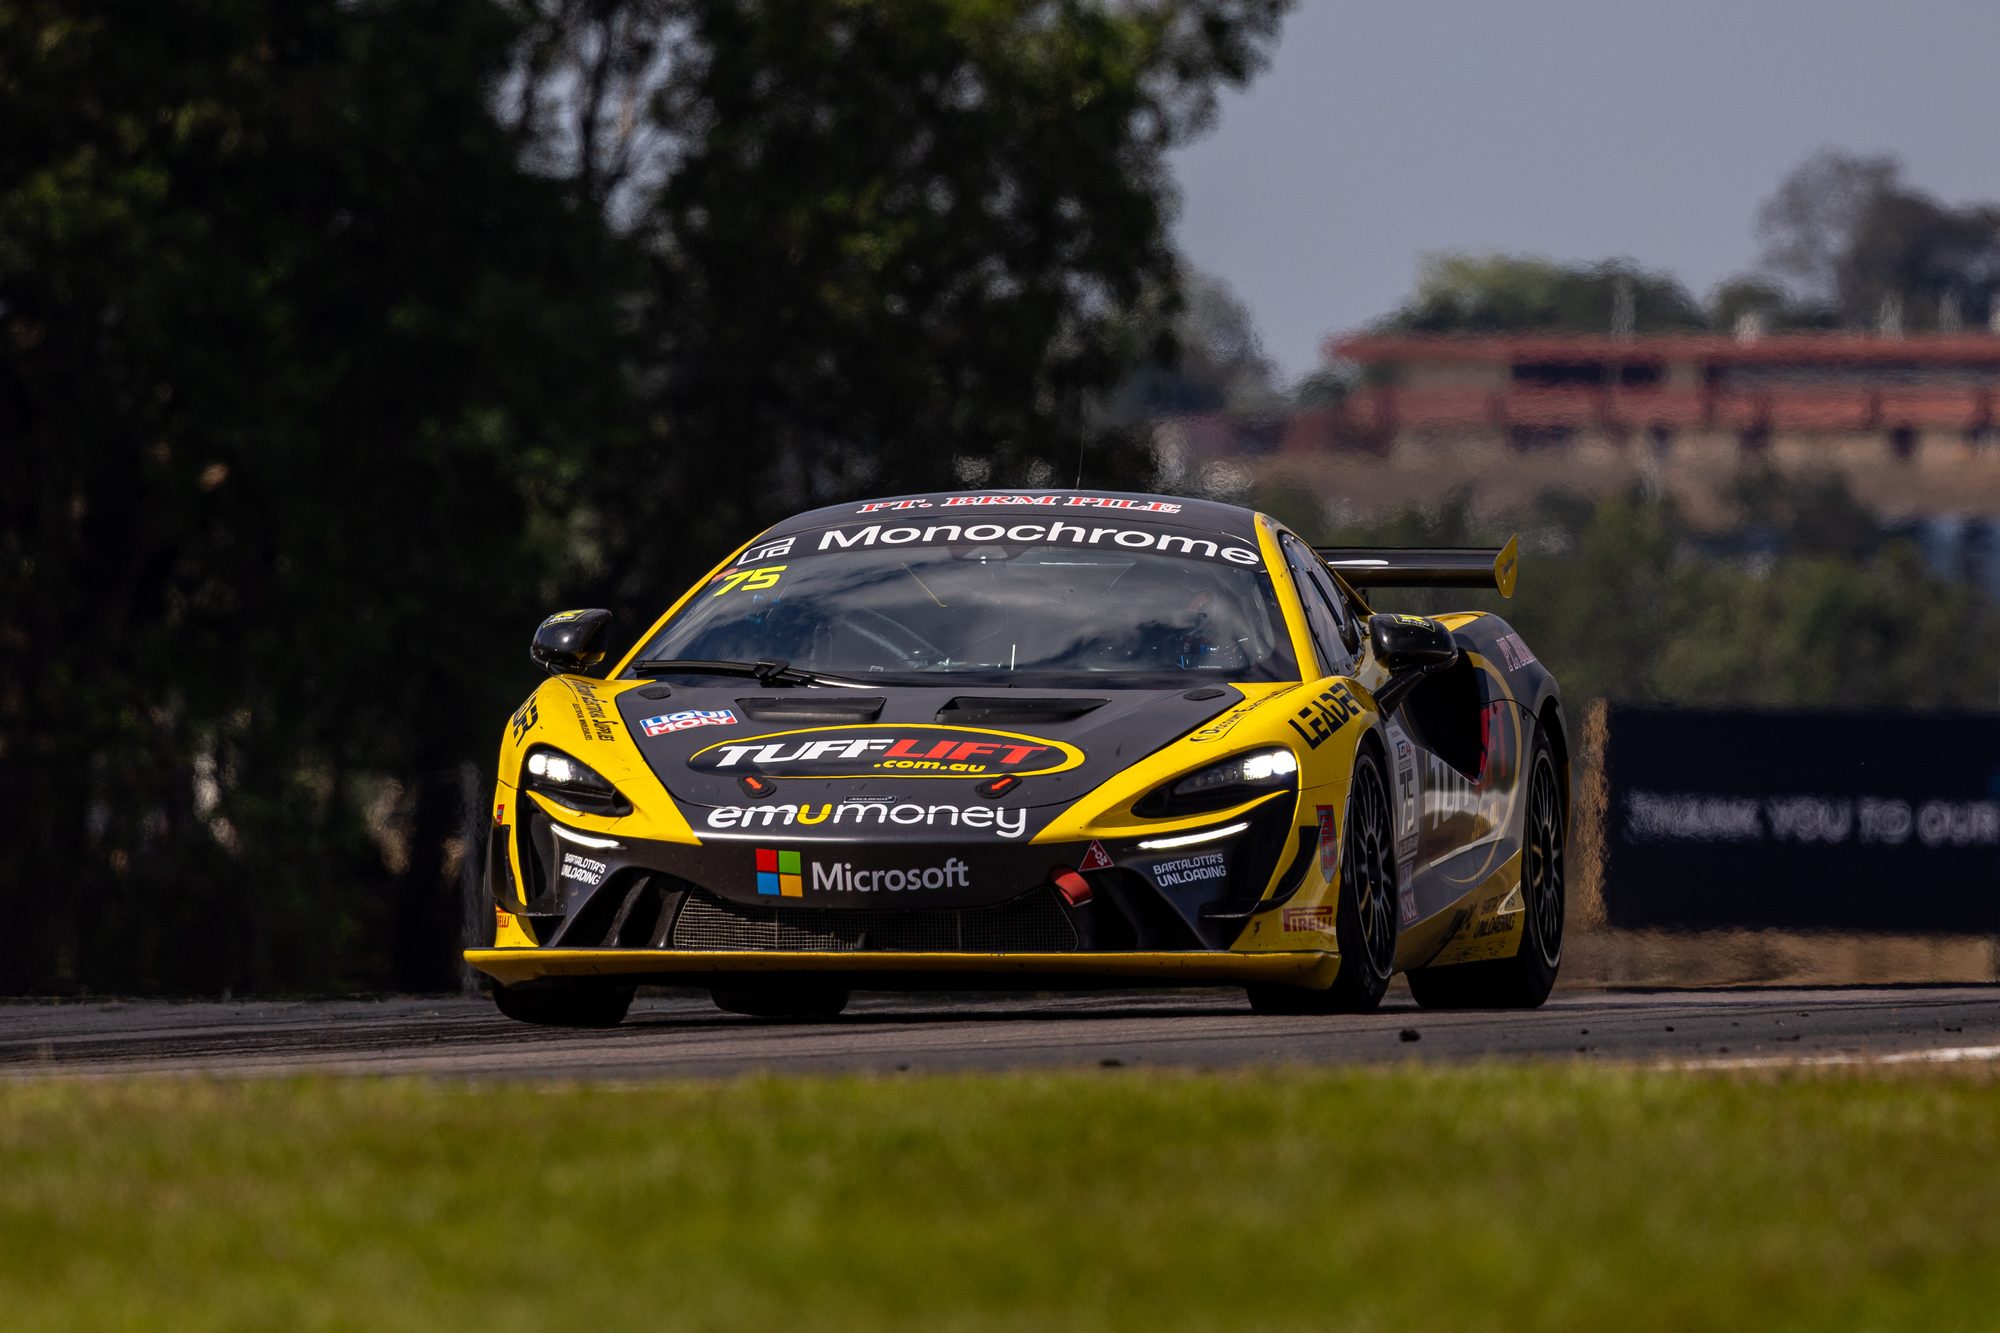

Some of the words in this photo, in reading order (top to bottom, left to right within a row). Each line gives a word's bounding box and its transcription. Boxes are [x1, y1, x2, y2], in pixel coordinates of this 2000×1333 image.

[856, 499, 932, 514] PT.
[941, 495, 1059, 507] BRM
[1063, 496, 1182, 514] PILE
[818, 521, 1261, 566] Monochrome
[713, 565, 787, 597] 75
[647, 710, 731, 727] LIQUI
[650, 717, 733, 735] MOLY
[716, 738, 1048, 768] TUFFLIFT
[873, 757, 986, 773] .com.au
[707, 801, 1026, 838] emumoney
[1767, 797, 1852, 843] YOU
[1858, 798, 1912, 844] TO
[1917, 799, 2000, 846] OUR
[564, 852, 606, 874] BARTALOTTA'S
[1091, 845, 1108, 866] TOW
[1153, 853, 1224, 875] BARTALOTTA'S
[561, 863, 602, 885] UNLOADING
[811, 857, 970, 894] Microsoft
[1157, 865, 1227, 887] UNLOADING
[1283, 906, 1333, 932] PIRELLI
